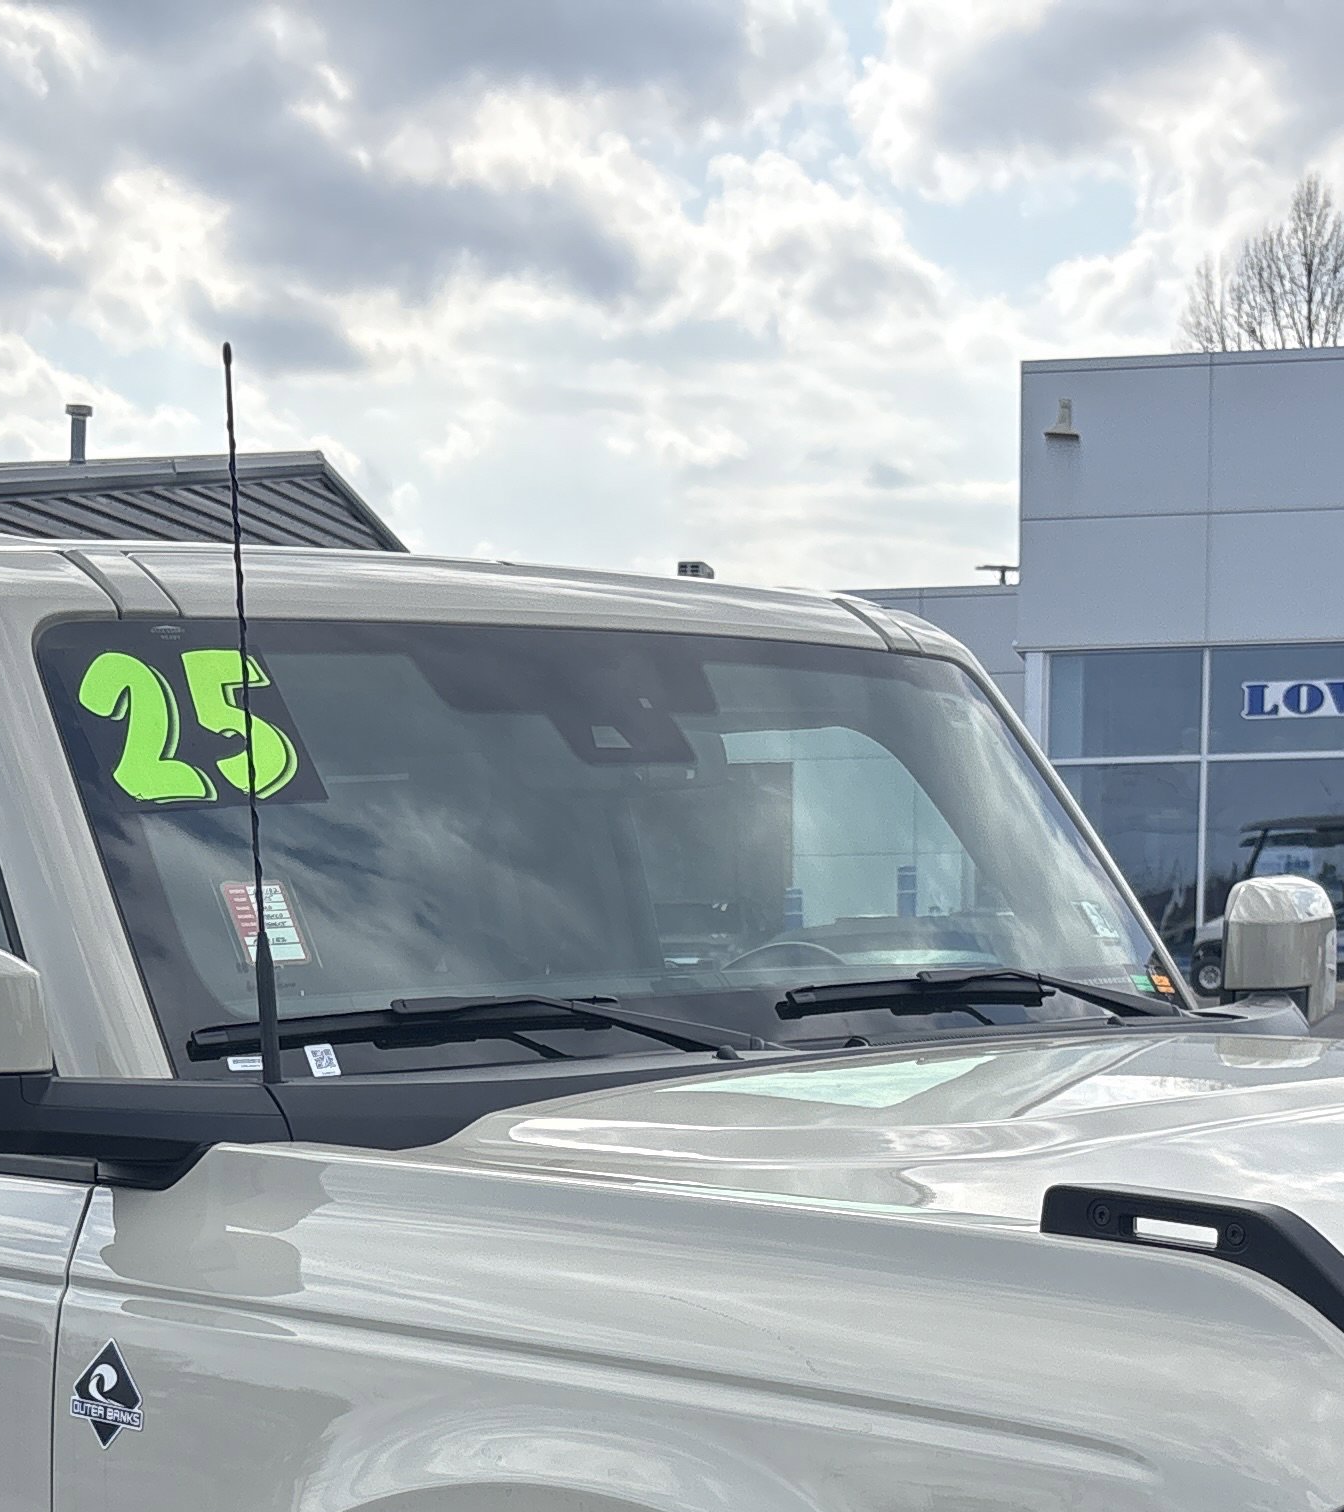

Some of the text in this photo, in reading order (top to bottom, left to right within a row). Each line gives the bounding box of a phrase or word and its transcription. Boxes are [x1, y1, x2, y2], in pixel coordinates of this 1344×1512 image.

[78, 647, 299, 804] 25
[74, 1401, 140, 1425] OUTER BANKS
